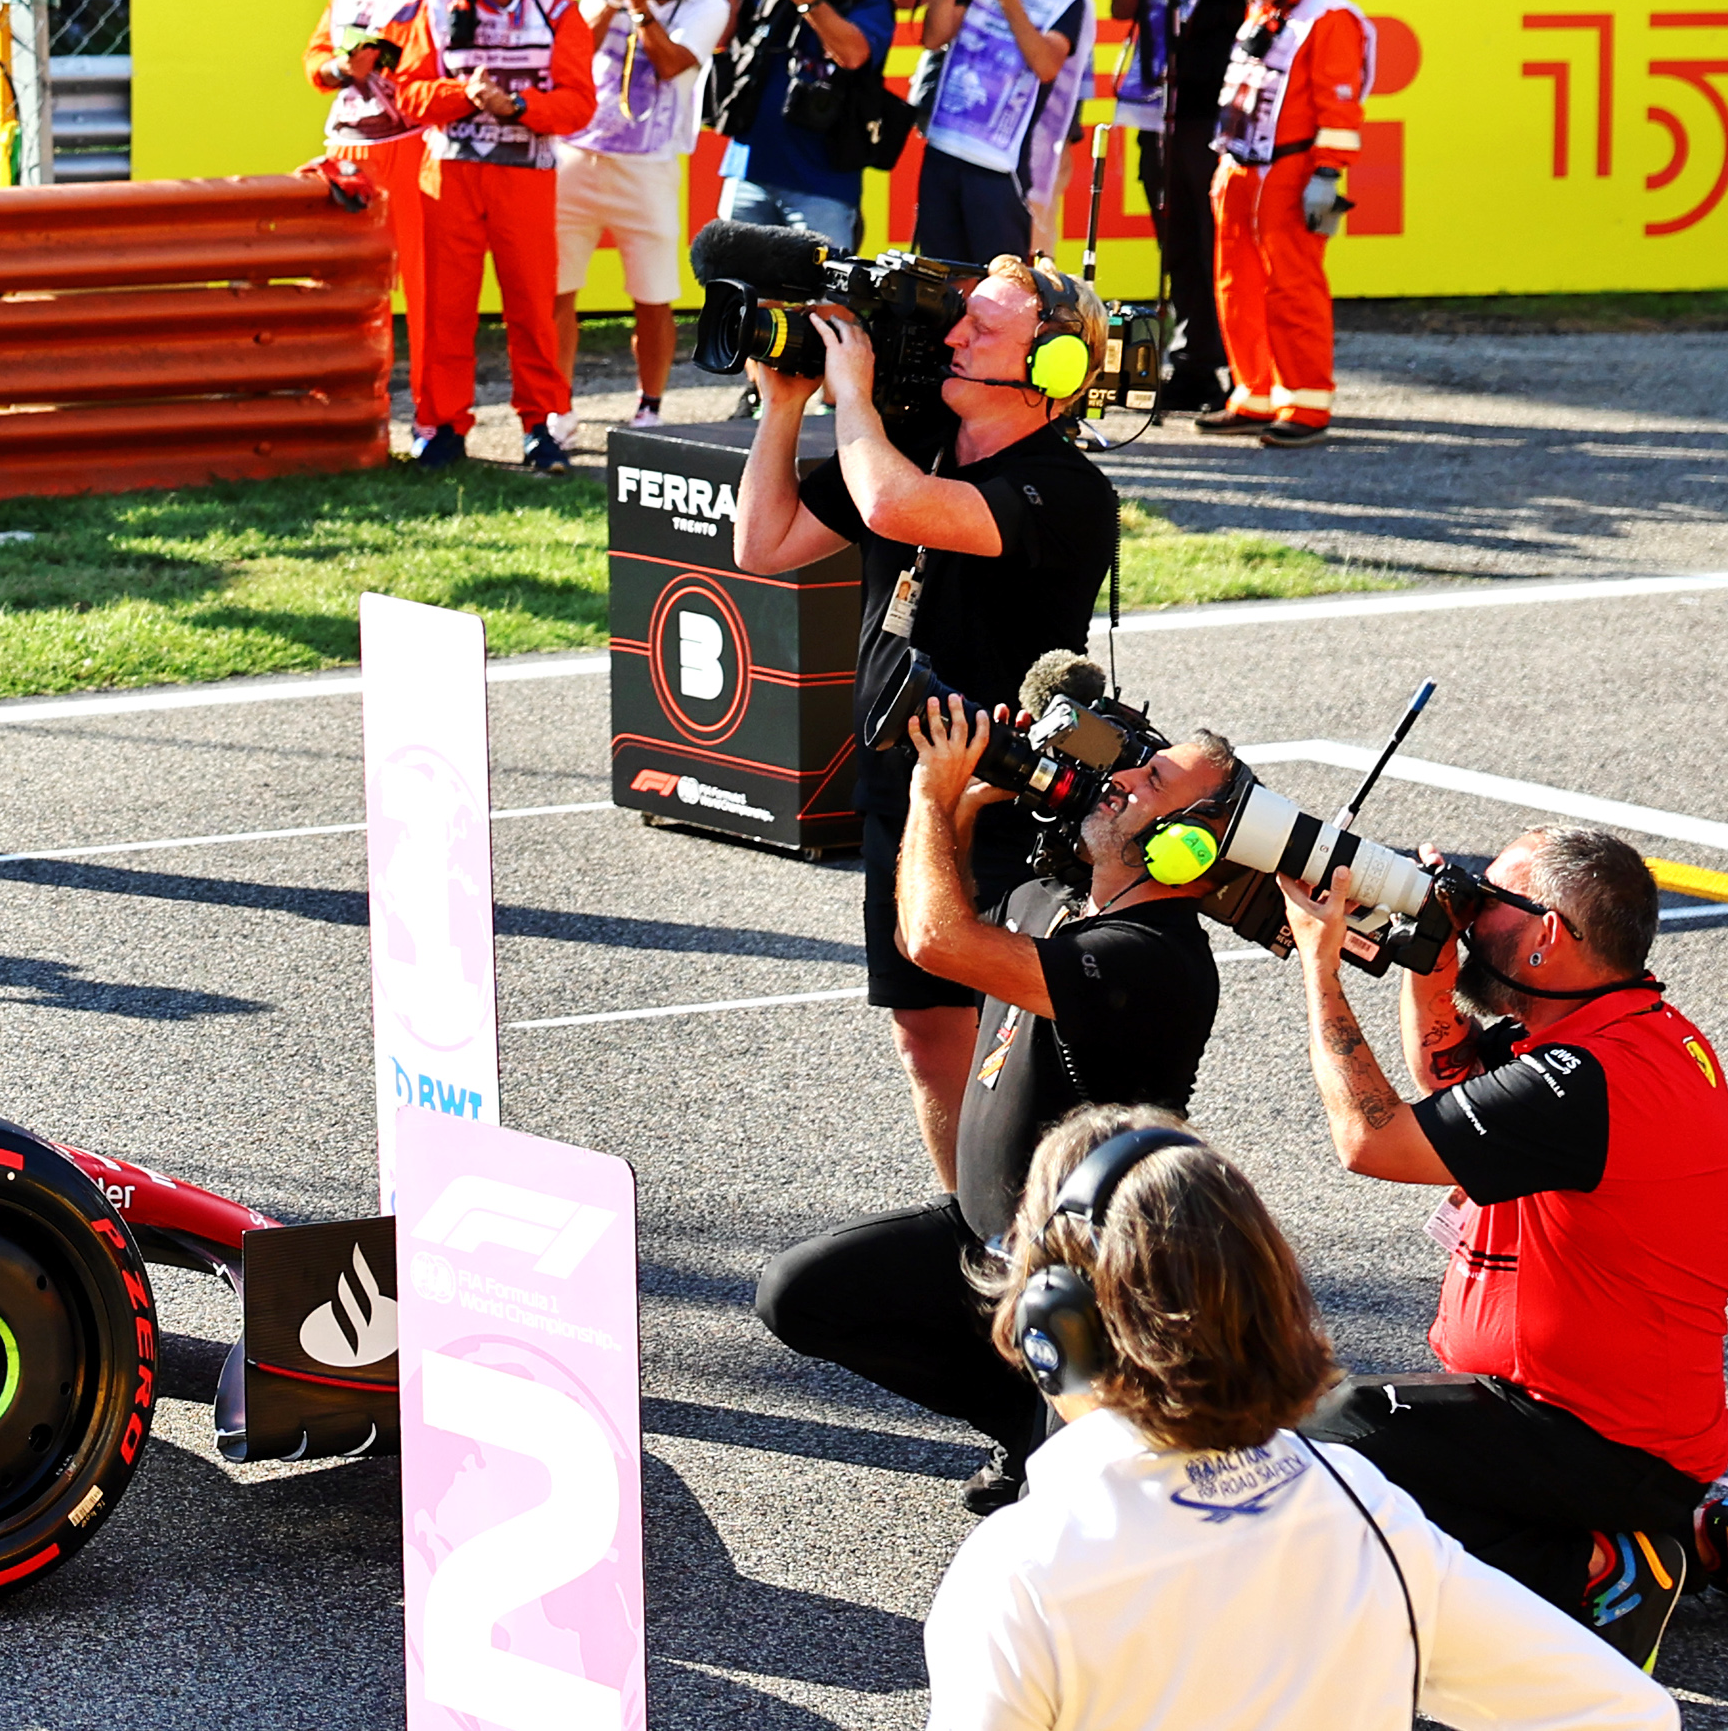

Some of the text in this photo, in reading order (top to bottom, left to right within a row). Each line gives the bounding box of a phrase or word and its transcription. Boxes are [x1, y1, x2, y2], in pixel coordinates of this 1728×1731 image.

[1088, 388, 1117, 402] DTC
[616, 465, 739, 523] FERRA
[671, 516, 718, 538] TRENTO
[458, 1289, 504, 1318] World
[459, 1269, 560, 1314] FIA Formula 1
[91, 1217, 126, 1250] P
[119, 1269, 156, 1467] ZERO
[1257, 1453, 1306, 1481] SAFETY
[422, 1348, 623, 1731] 2
